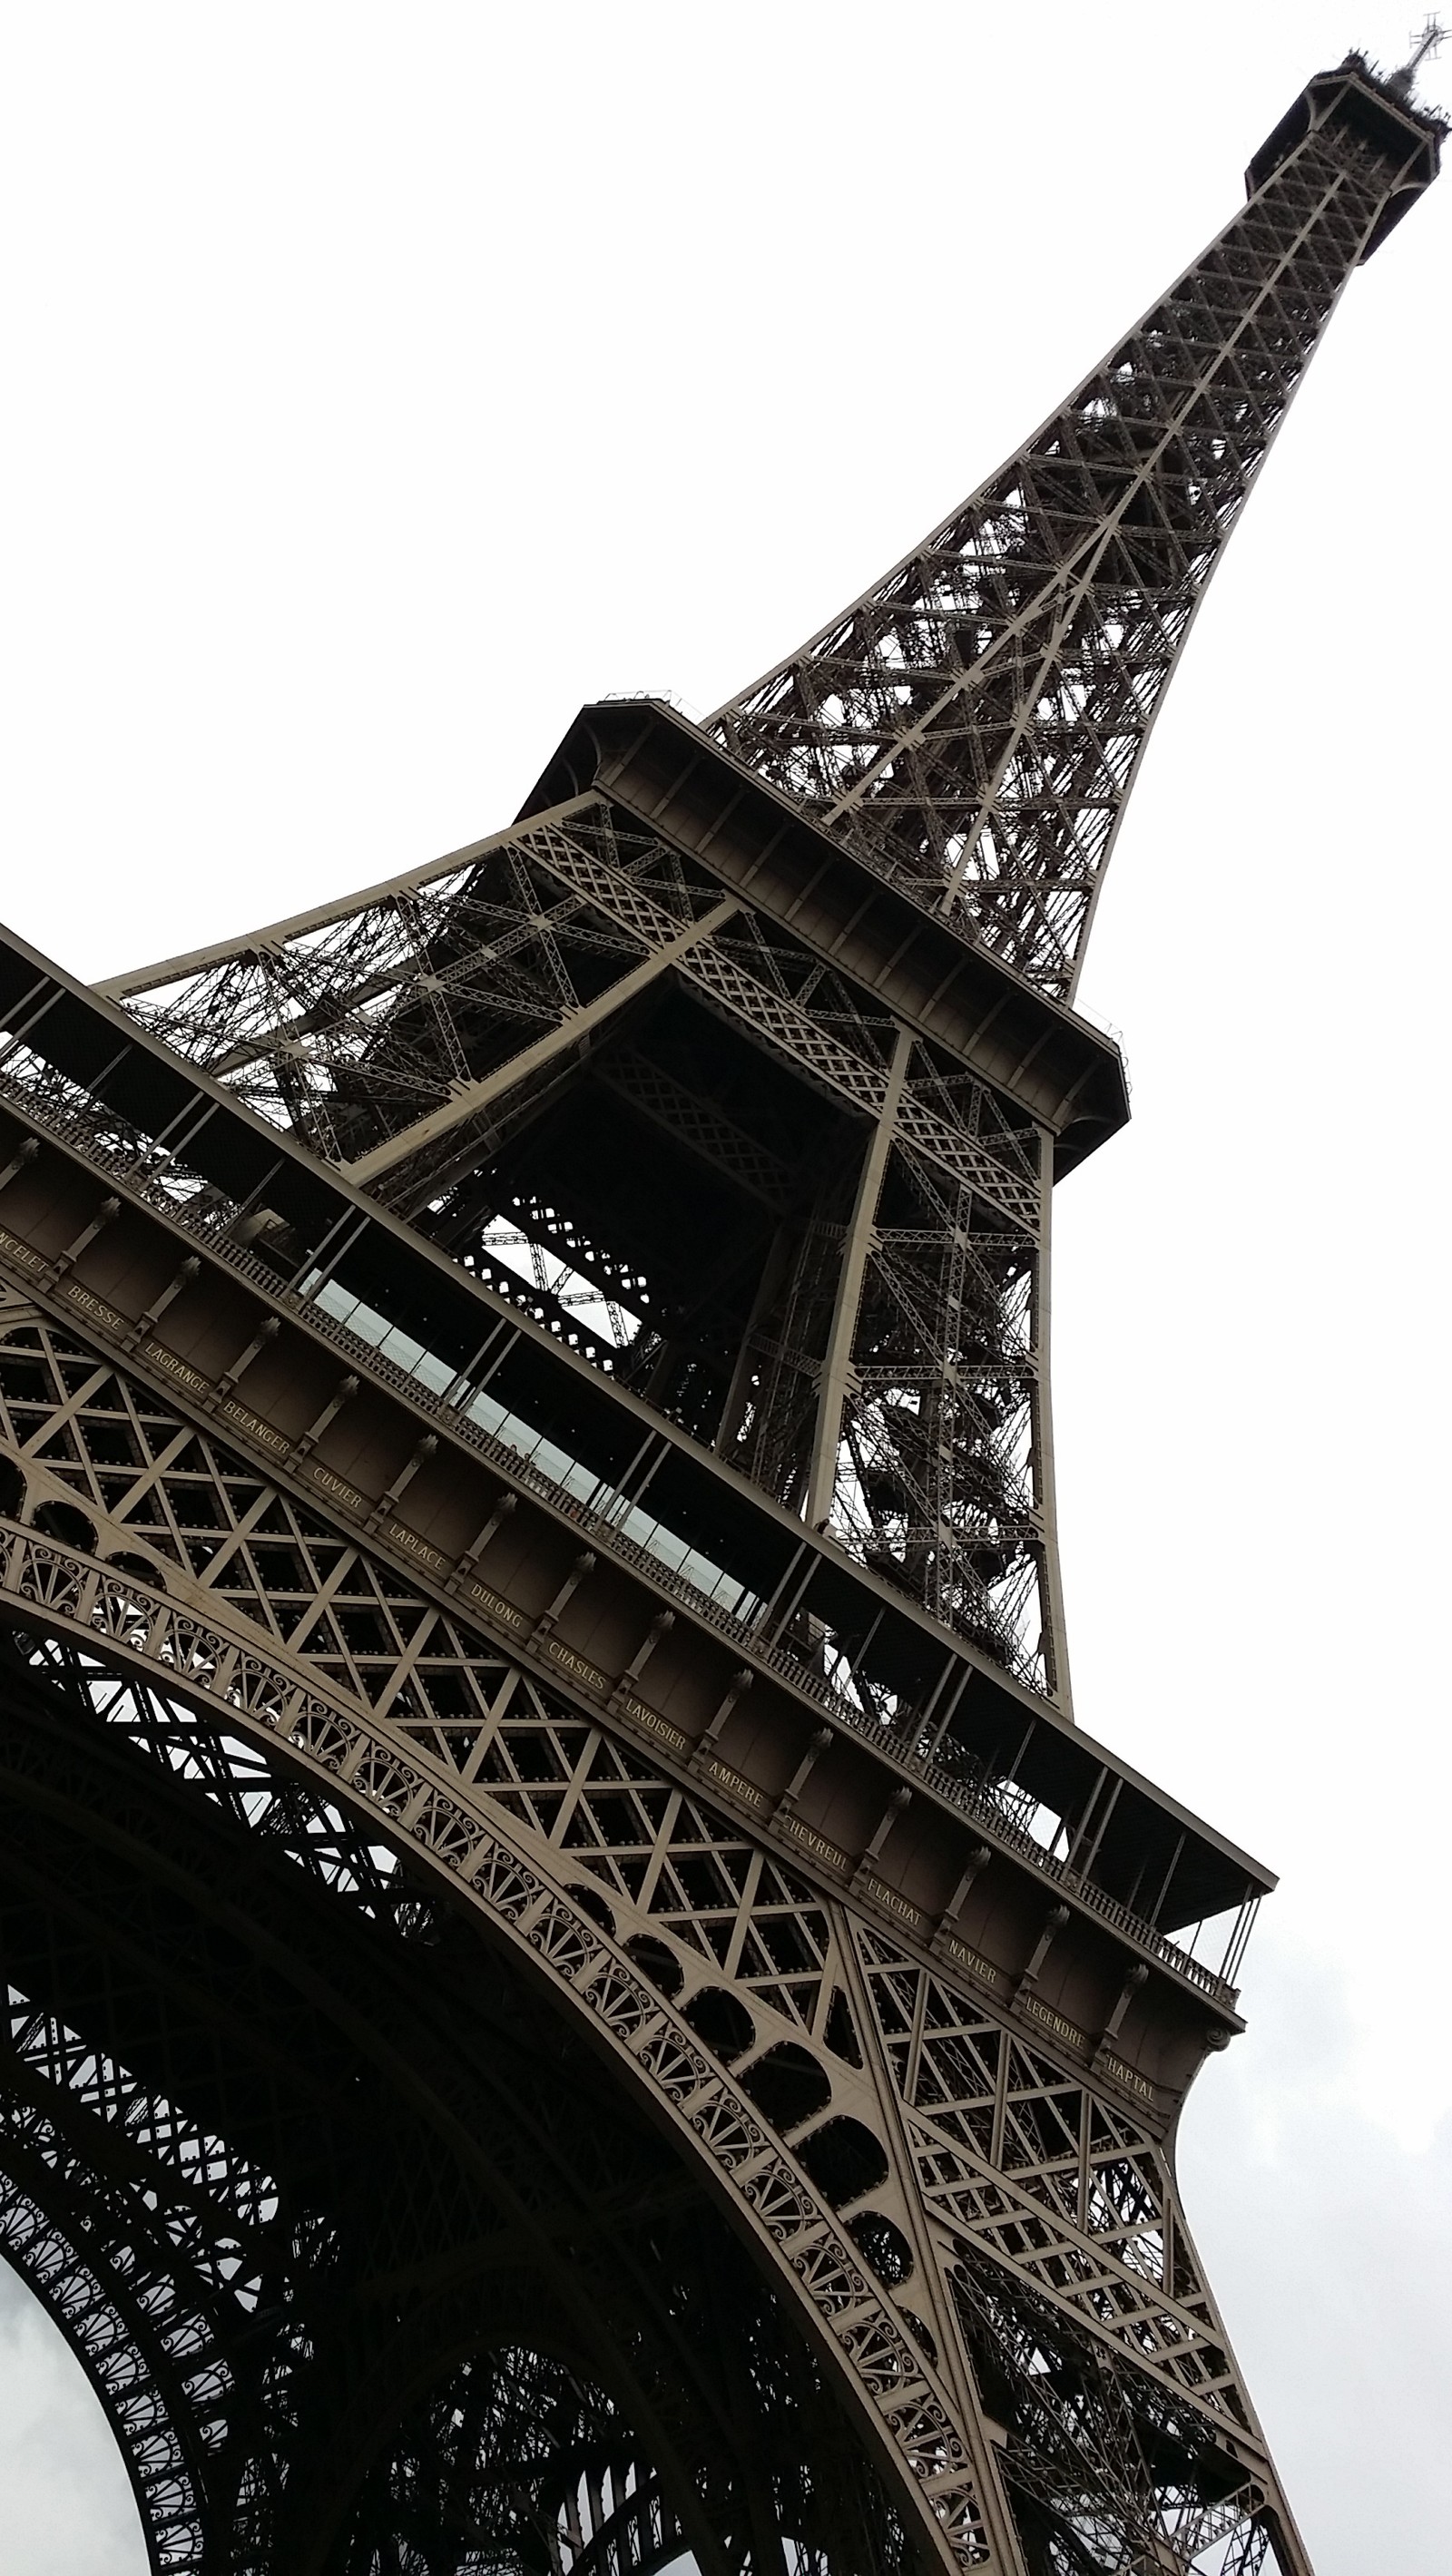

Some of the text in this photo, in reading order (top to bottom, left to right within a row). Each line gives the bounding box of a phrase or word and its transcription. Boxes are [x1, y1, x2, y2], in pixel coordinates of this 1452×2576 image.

[67, 1285, 124, 1331] BRESSE
[145, 1342, 210, 1394] LAGRANGE
[223, 1401, 290, 1455] BELANGER
[313, 1467, 362, 1508] CUVIER
[388, 1523, 446, 1571] LAPLACE
[471, 1583, 524, 1628] DULONG
[548, 1641, 606, 1690] CHASLES
[626, 1699, 686, 1750] LAVOISIER
[709, 1762, 763, 1807] AMPERE
[867, 1878, 922, 1926] FLACHAT
[948, 1939, 996, 1983] NAVIER
[1026, 1996, 1085, 2049] LEGENDRE
[1104, 2054, 1153, 2101] HAPTAL
